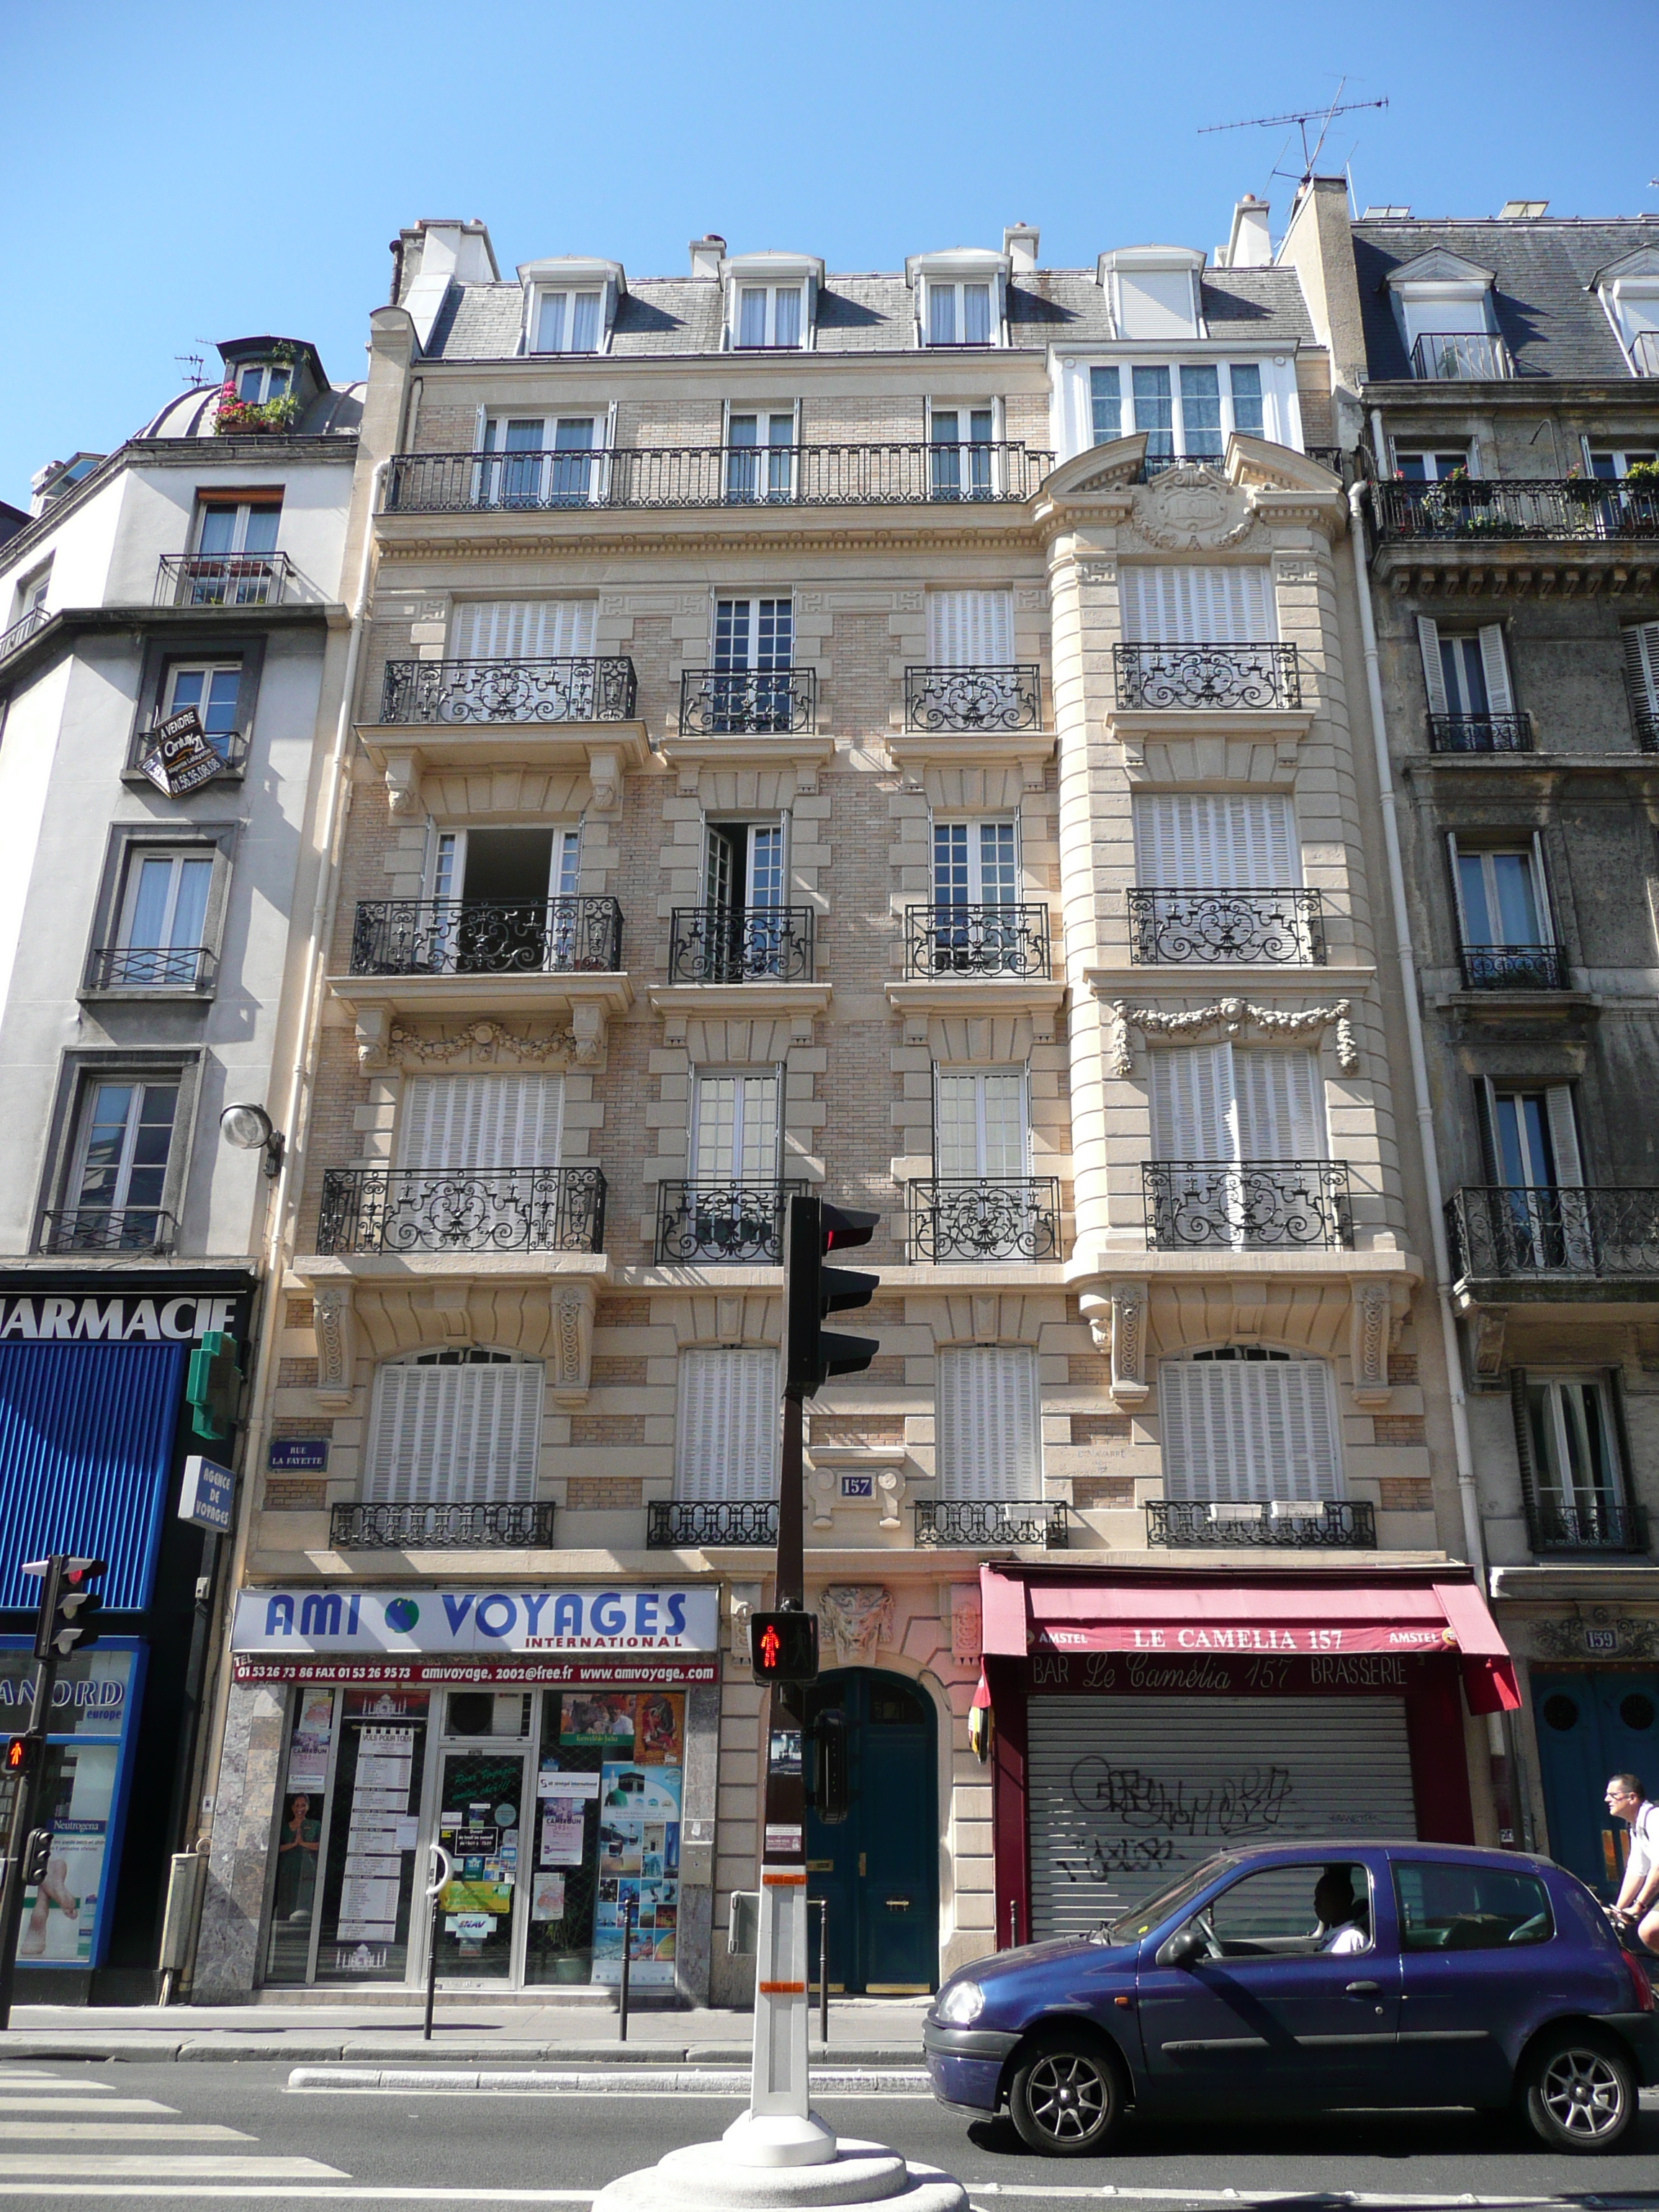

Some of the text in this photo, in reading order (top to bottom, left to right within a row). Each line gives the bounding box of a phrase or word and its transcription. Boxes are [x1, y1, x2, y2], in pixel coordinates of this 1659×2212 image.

[161, 711, 196, 740] A VENDRE
[165, 733, 204, 757] Century 21
[171, 758, 220, 793] 01.56.35.08.08
[0, 1298, 236, 1339] ARMACIE
[272, 1457, 323, 1465] LA FAYETTE
[203, 1467, 230, 1491] AGENCE
[845, 1479, 870, 1494] 157
[209, 1488, 220, 1503] DE
[196, 1501, 229, 1525] VOYAGES
[265, 1592, 686, 1638] AMI VOYAGES
[525, 1636, 683, 1648] INTERNATIONAL
[1039, 1629, 1439, 1650] AMSTEL LE CAMELIA 157 AMSTEL
[1588, 1632, 1613, 1647] 159
[234, 1653, 253, 1667] TEL
[238, 1666, 250, 1678] 01
[251, 1666, 265, 1678] 53
[266, 1666, 280, 1678] 26
[282, 1667, 296, 1678] 73
[299, 1667, 313, 1678] 86
[315, 1668, 336, 1678] FAX
[338, 1667, 350, 1678] 01
[352, 1667, 366, 1678] 53
[367, 1667, 381, 1678] 26
[1033, 1650, 1408, 1689] BAR Le Camélia 157 BRASSERIE
[86, 1710, 122, 1721] europe
[54, 1820, 99, 1833] Neutrogena
